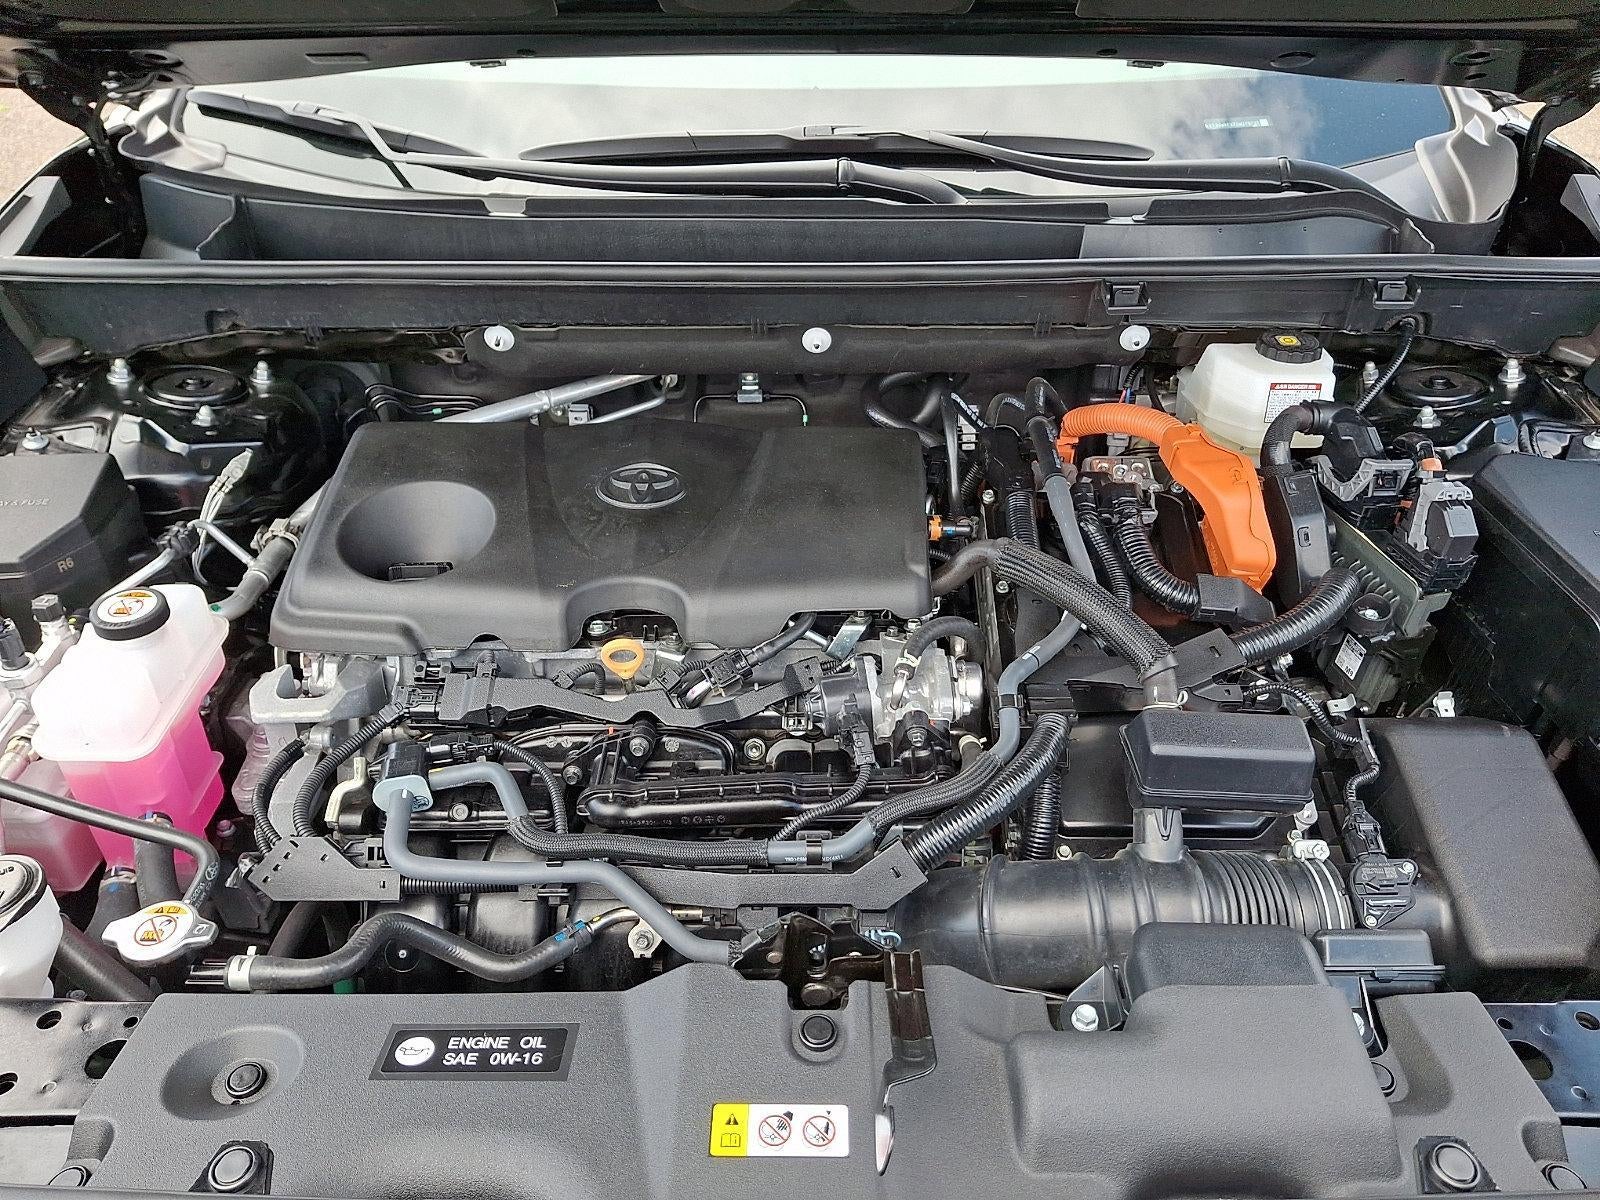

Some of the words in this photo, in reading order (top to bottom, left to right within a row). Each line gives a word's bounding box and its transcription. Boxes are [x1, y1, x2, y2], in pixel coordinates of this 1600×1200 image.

[57, 557, 74, 573] R6
[448, 1036, 510, 1049] ENGINE
[519, 1036, 547, 1049] OIL
[442, 1052, 479, 1066] SAE
[488, 1052, 543, 1066] 0W-16
